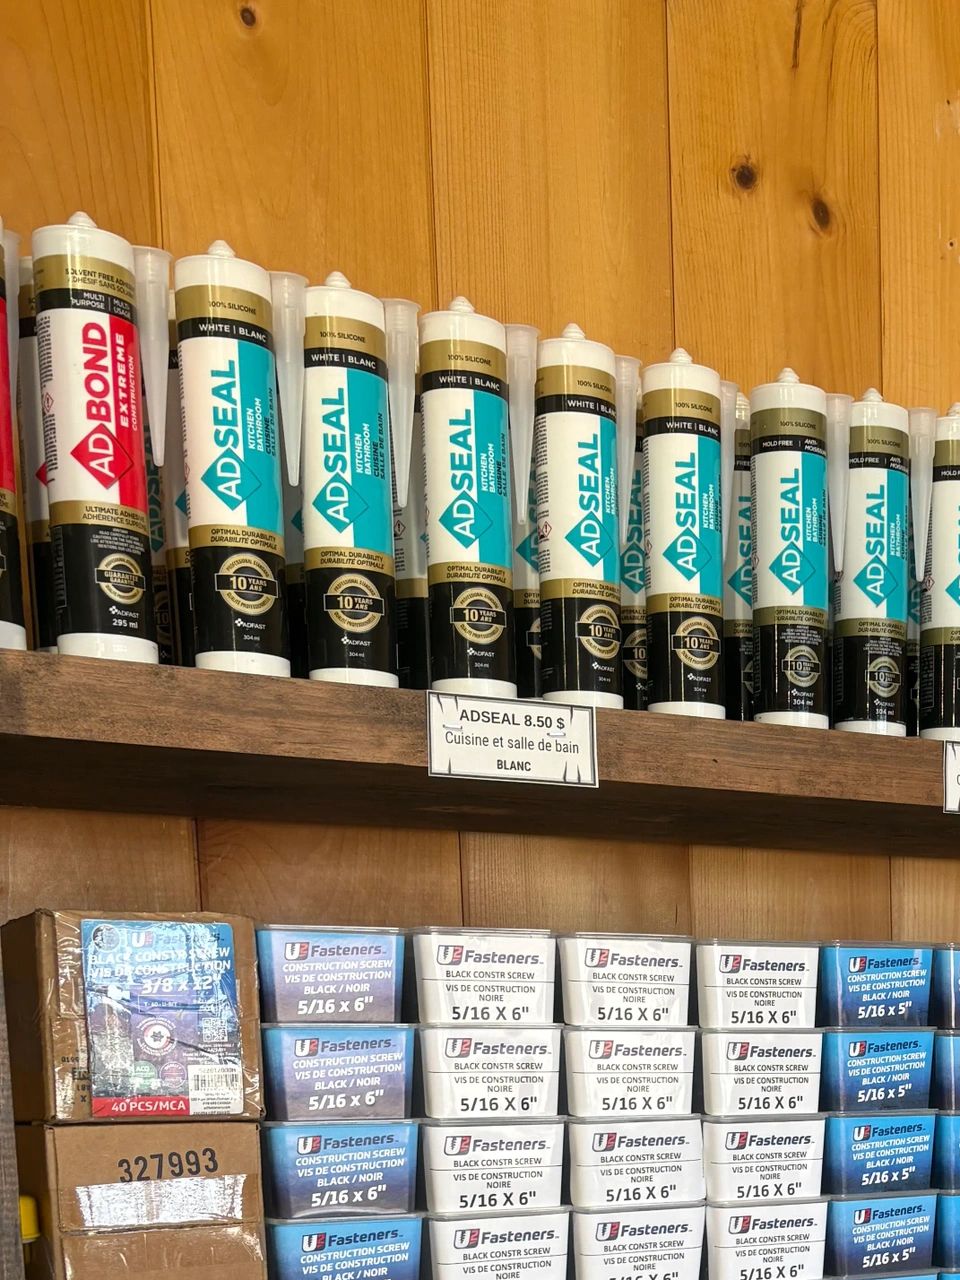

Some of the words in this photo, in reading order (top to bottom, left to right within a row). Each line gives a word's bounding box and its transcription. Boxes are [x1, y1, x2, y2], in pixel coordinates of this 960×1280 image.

[198, 322, 234, 336] WHITE
[238, 326, 268, 342] BLANC
[85, 321, 119, 478] ADBOND
[116, 332, 130, 428] EXTREME
[212, 359, 244, 504] ADSEAL
[248, 405, 256, 452] KITCHEN
[322, 386, 350, 525] ADSEAL
[446, 408, 476, 542] ADSEAL
[672, 451, 696, 578] ADSEAL
[445, 732, 489, 747] Cuisine
[493, 736, 504, 748] et
[507, 736, 534, 750] salle
[538, 739, 552, 751] de
[556, 740, 579, 754] bain
[460, 709, 520, 726] ADSEAL
[524, 715, 552, 728] 8.50
[556, 718, 565, 730] $
[496, 760, 531, 772] BLANC
[112, 1102, 127, 1112] 40
[132, 1100, 186, 1111] PCS/MCA
[118, 1148, 219, 1183] 327993
